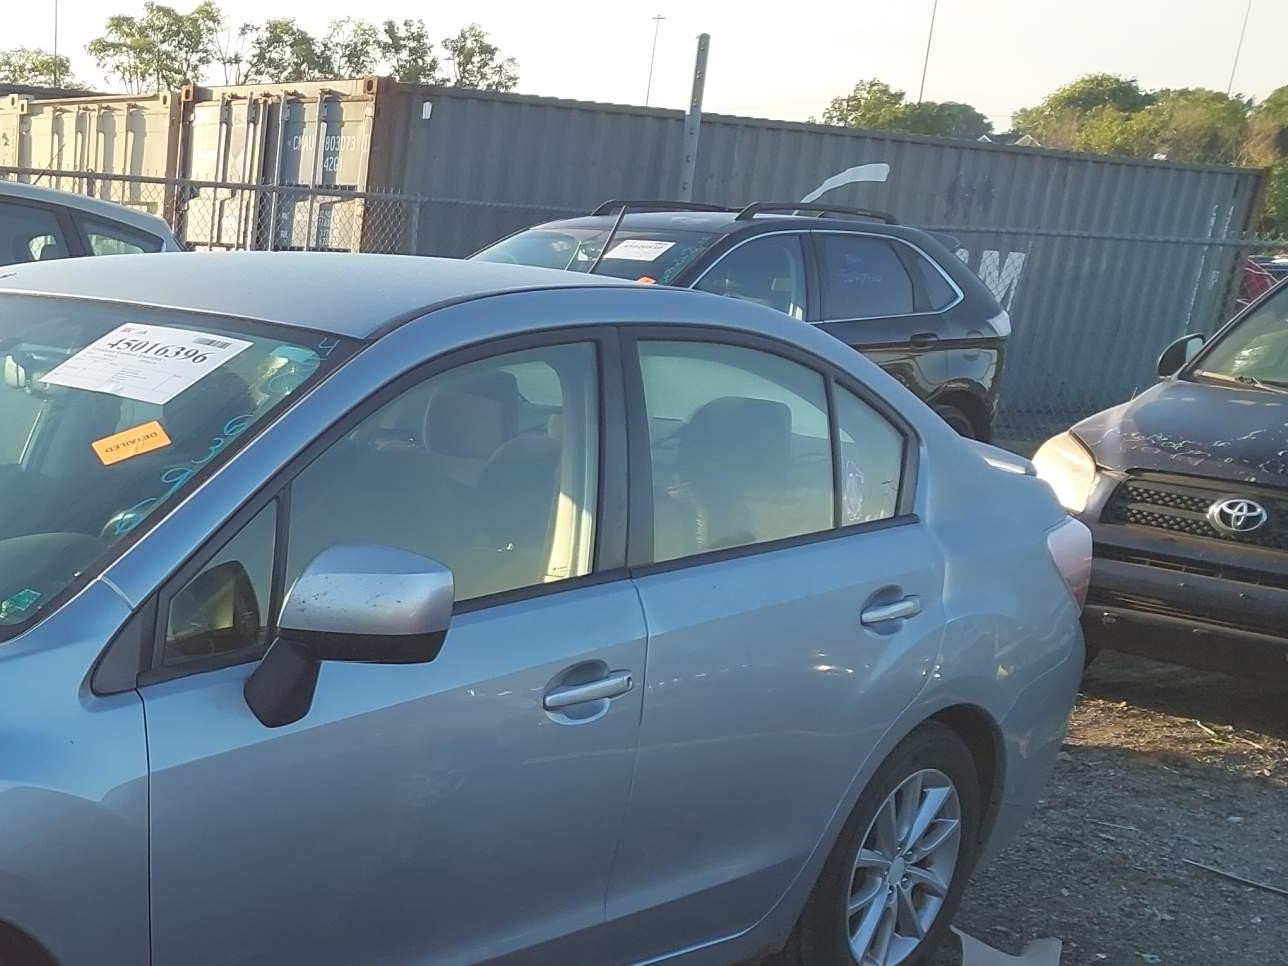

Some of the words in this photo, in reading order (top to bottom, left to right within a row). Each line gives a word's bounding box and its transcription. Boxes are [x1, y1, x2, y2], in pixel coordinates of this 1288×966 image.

[324, 135, 356, 152] 803073
[106, 337, 215, 364] 45016396
[105, 431, 159, 453] DETAILED
